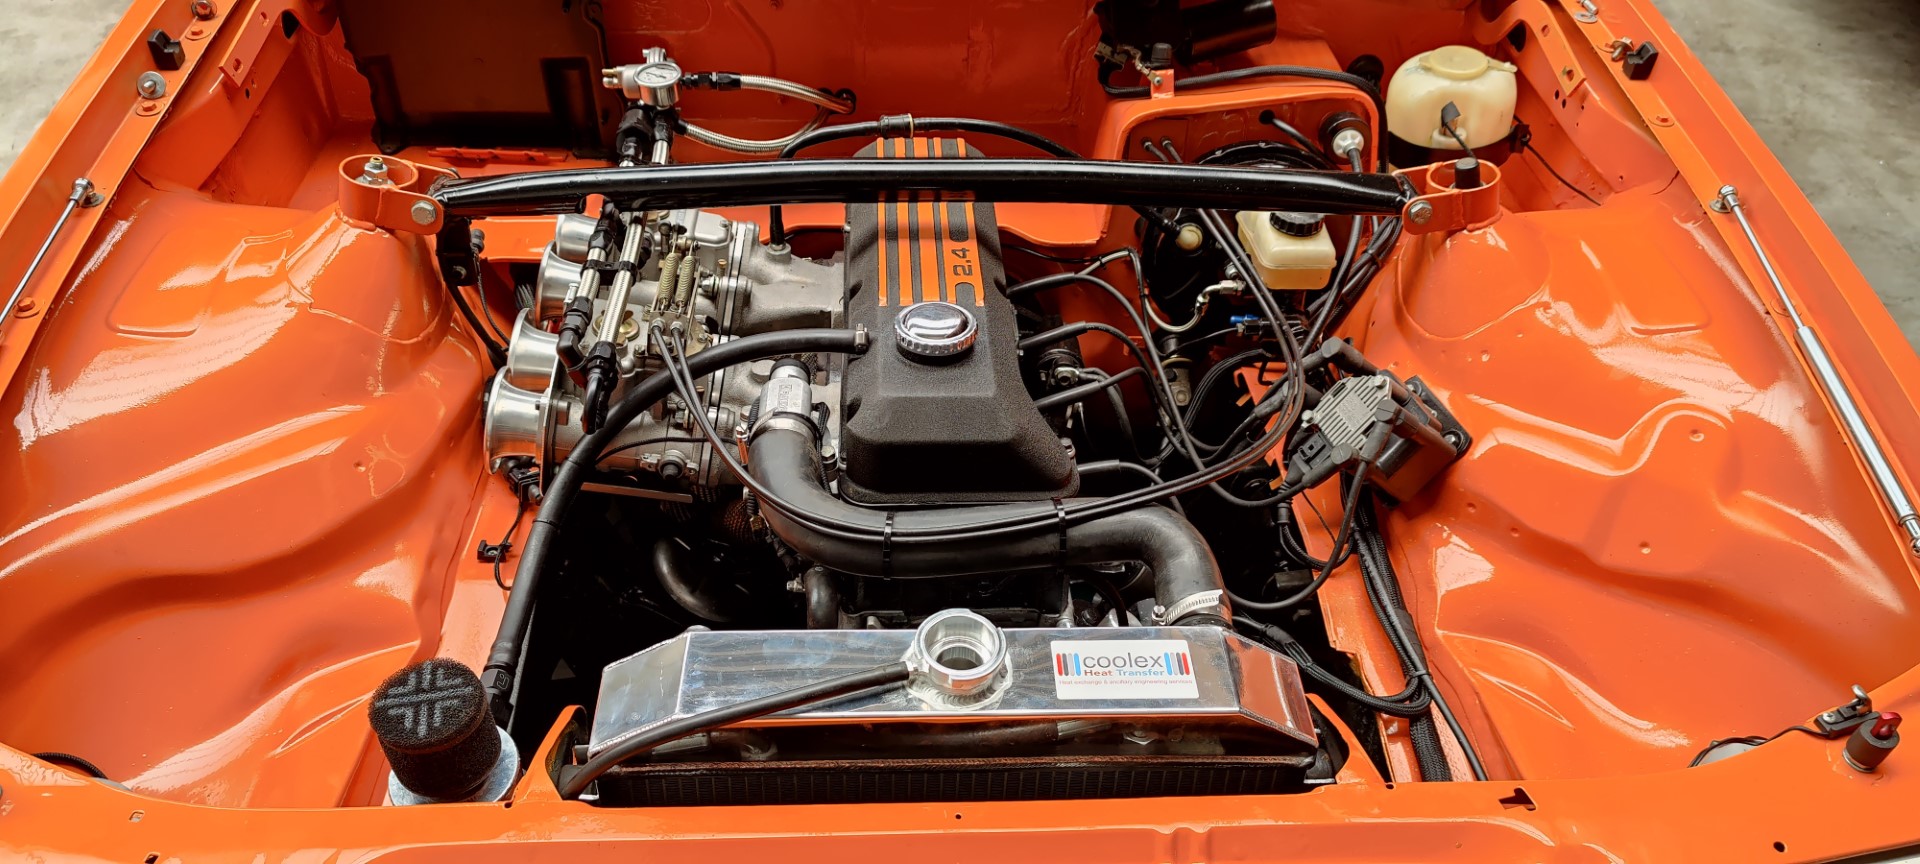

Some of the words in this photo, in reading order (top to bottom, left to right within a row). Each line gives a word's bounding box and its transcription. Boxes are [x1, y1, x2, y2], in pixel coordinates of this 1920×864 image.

[951, 247, 973, 277] 2.4
[1083, 652, 1164, 669] coolex
[1084, 669, 1113, 677] Heat
[1116, 668, 1165, 677] Transfer
